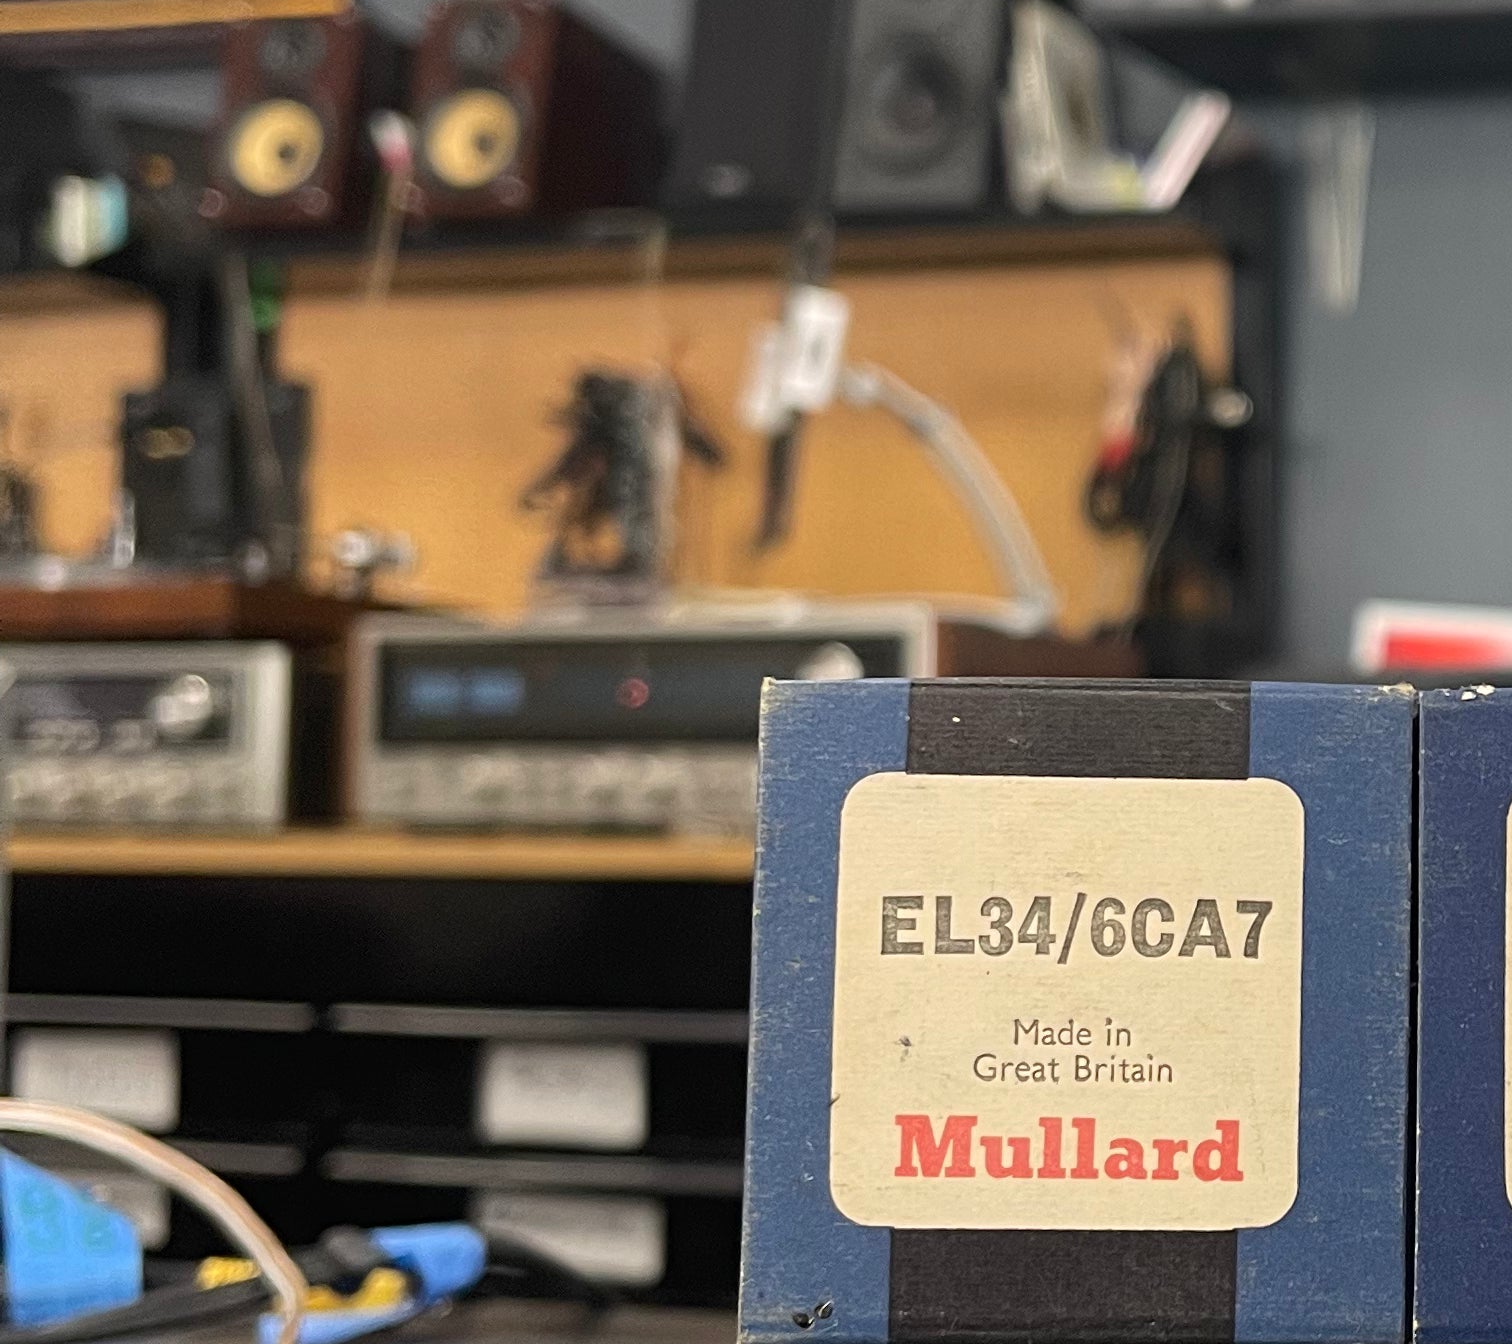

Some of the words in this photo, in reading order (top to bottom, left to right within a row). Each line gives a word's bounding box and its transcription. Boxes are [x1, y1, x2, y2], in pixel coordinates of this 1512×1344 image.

[880, 891, 1274, 965] EL34/6CA7
[1012, 1017, 1092, 1047] Made
[1106, 1017, 1132, 1047] in
[972, 1054, 1060, 1084] Great
[1074, 1053, 1174, 1084] Britain
[893, 1114, 1245, 1182] Mullard
